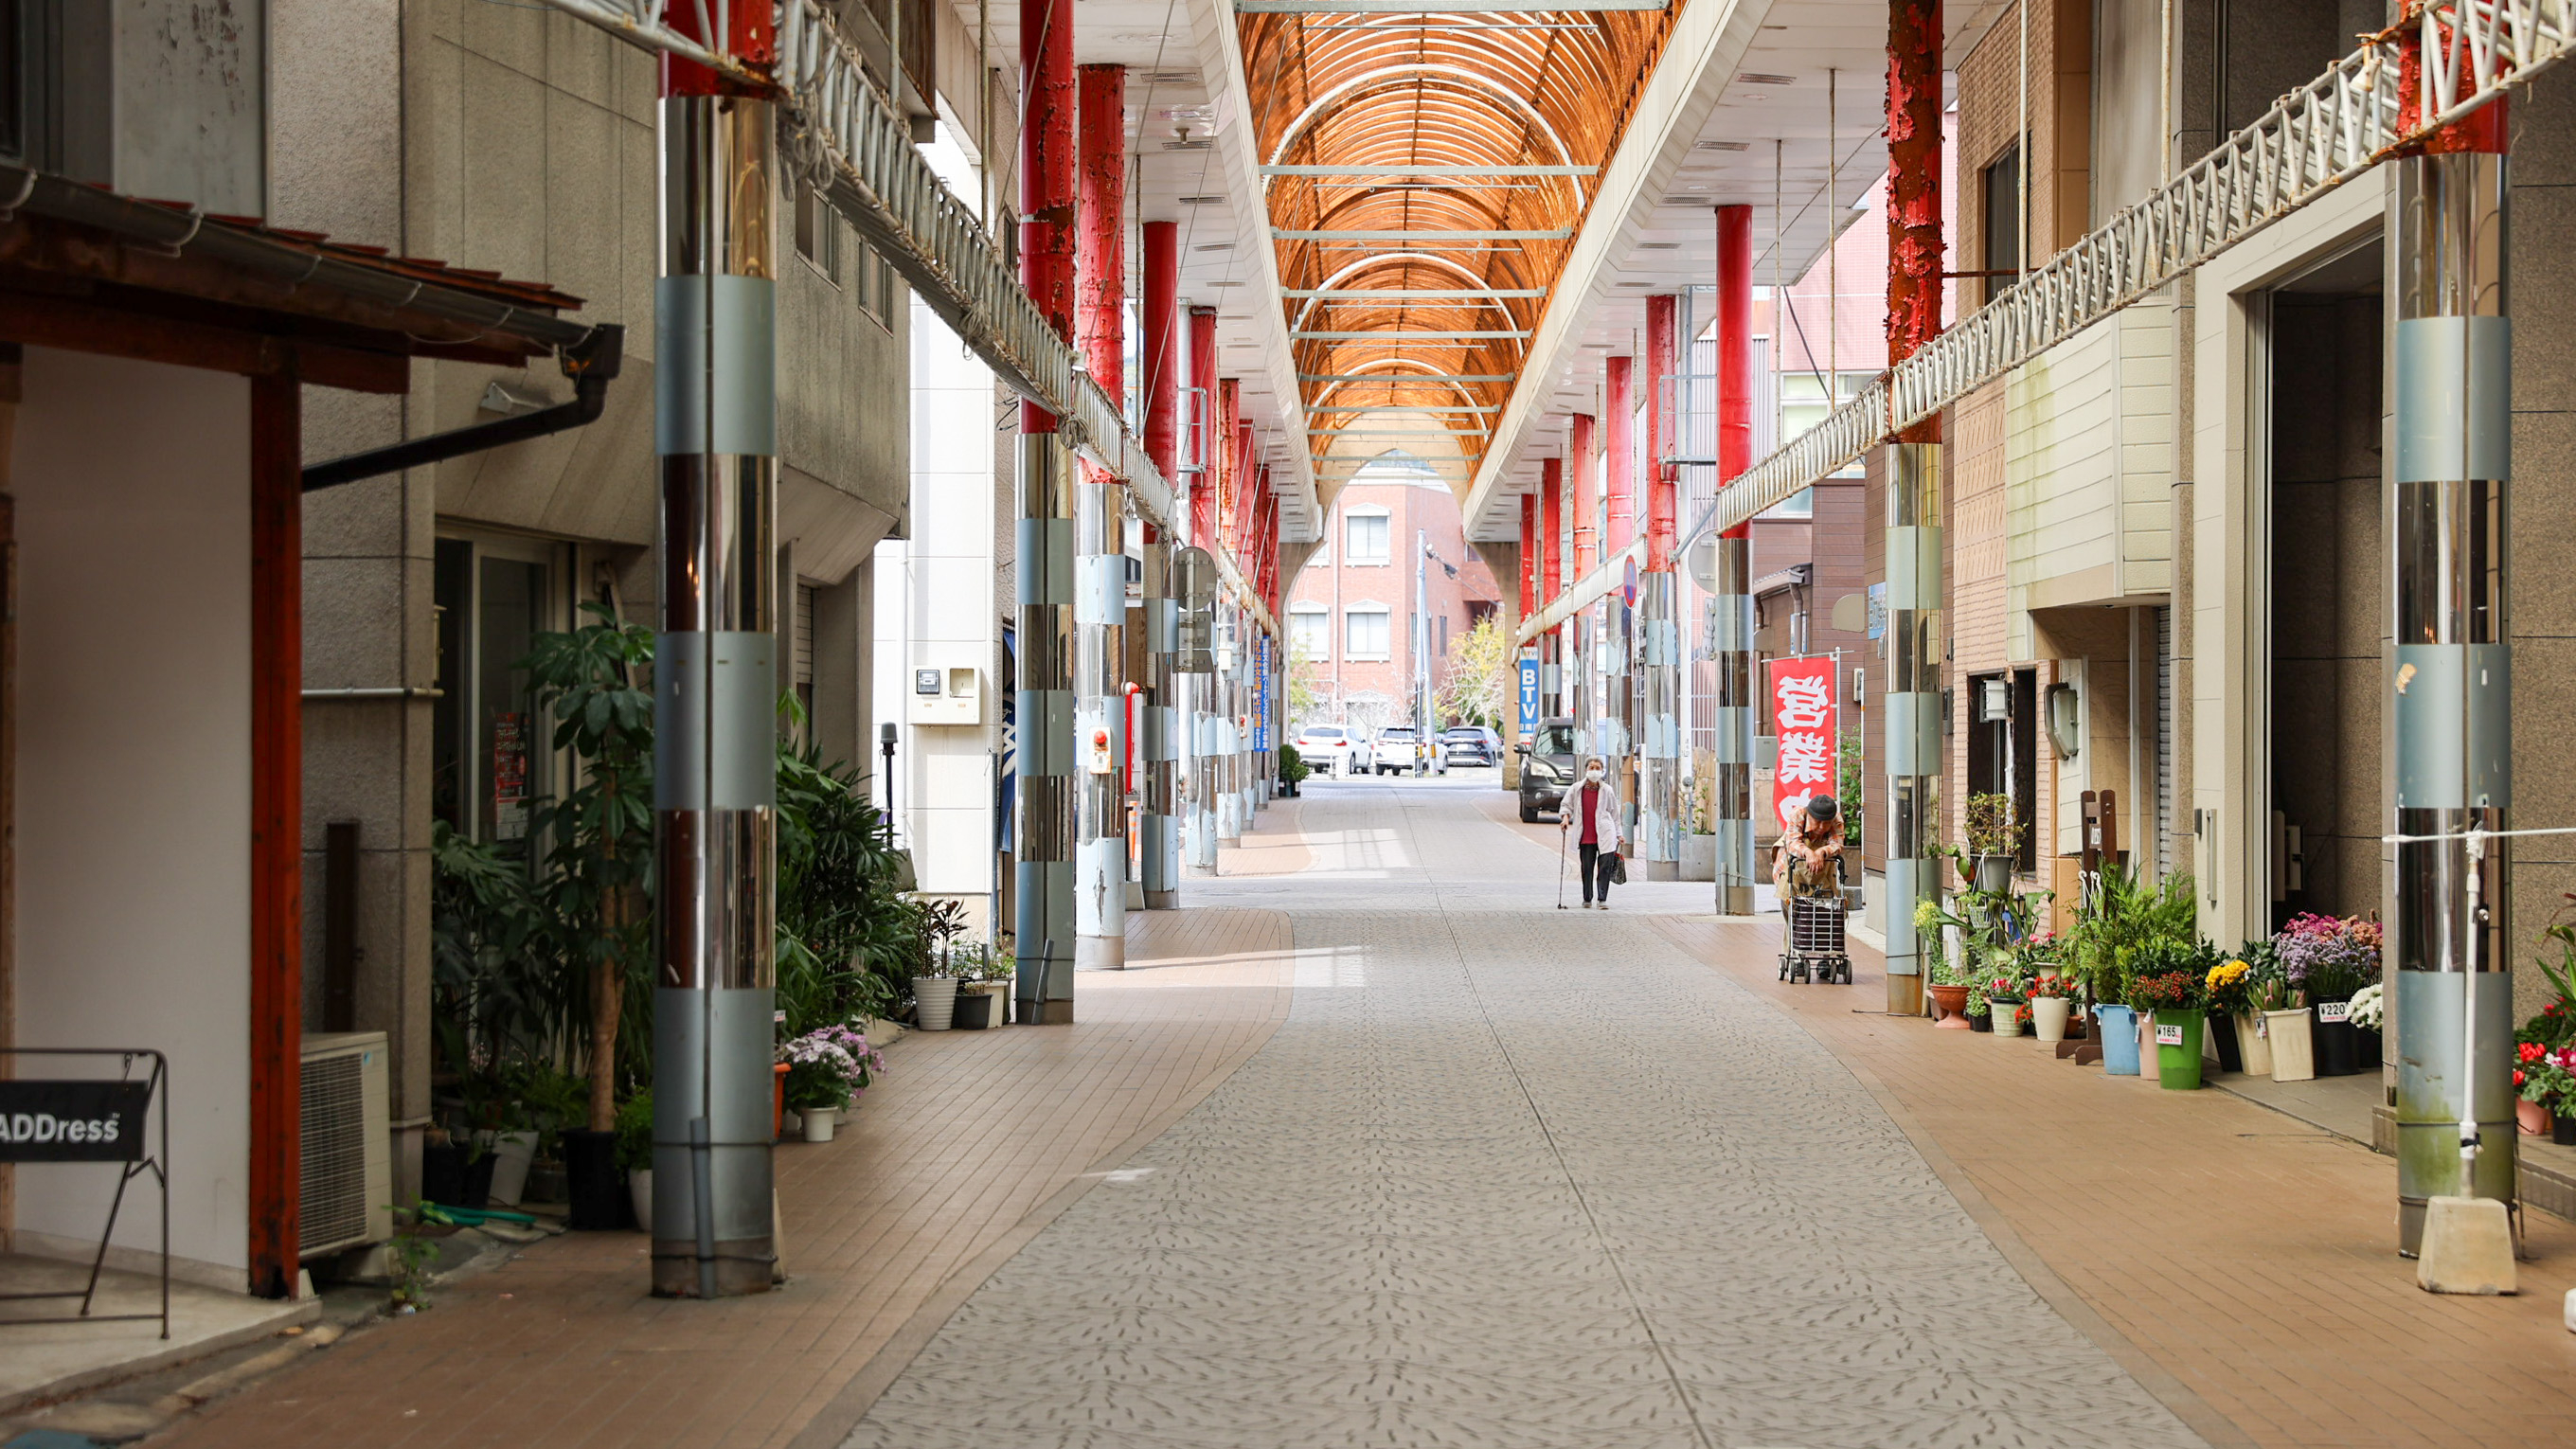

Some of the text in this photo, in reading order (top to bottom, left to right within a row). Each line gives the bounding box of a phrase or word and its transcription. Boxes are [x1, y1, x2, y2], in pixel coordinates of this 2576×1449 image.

[1522, 669, 1536, 720] BTV
[2320, 1004, 2346, 1015] ¥220
[2156, 1026, 2176, 1037] ¥165
